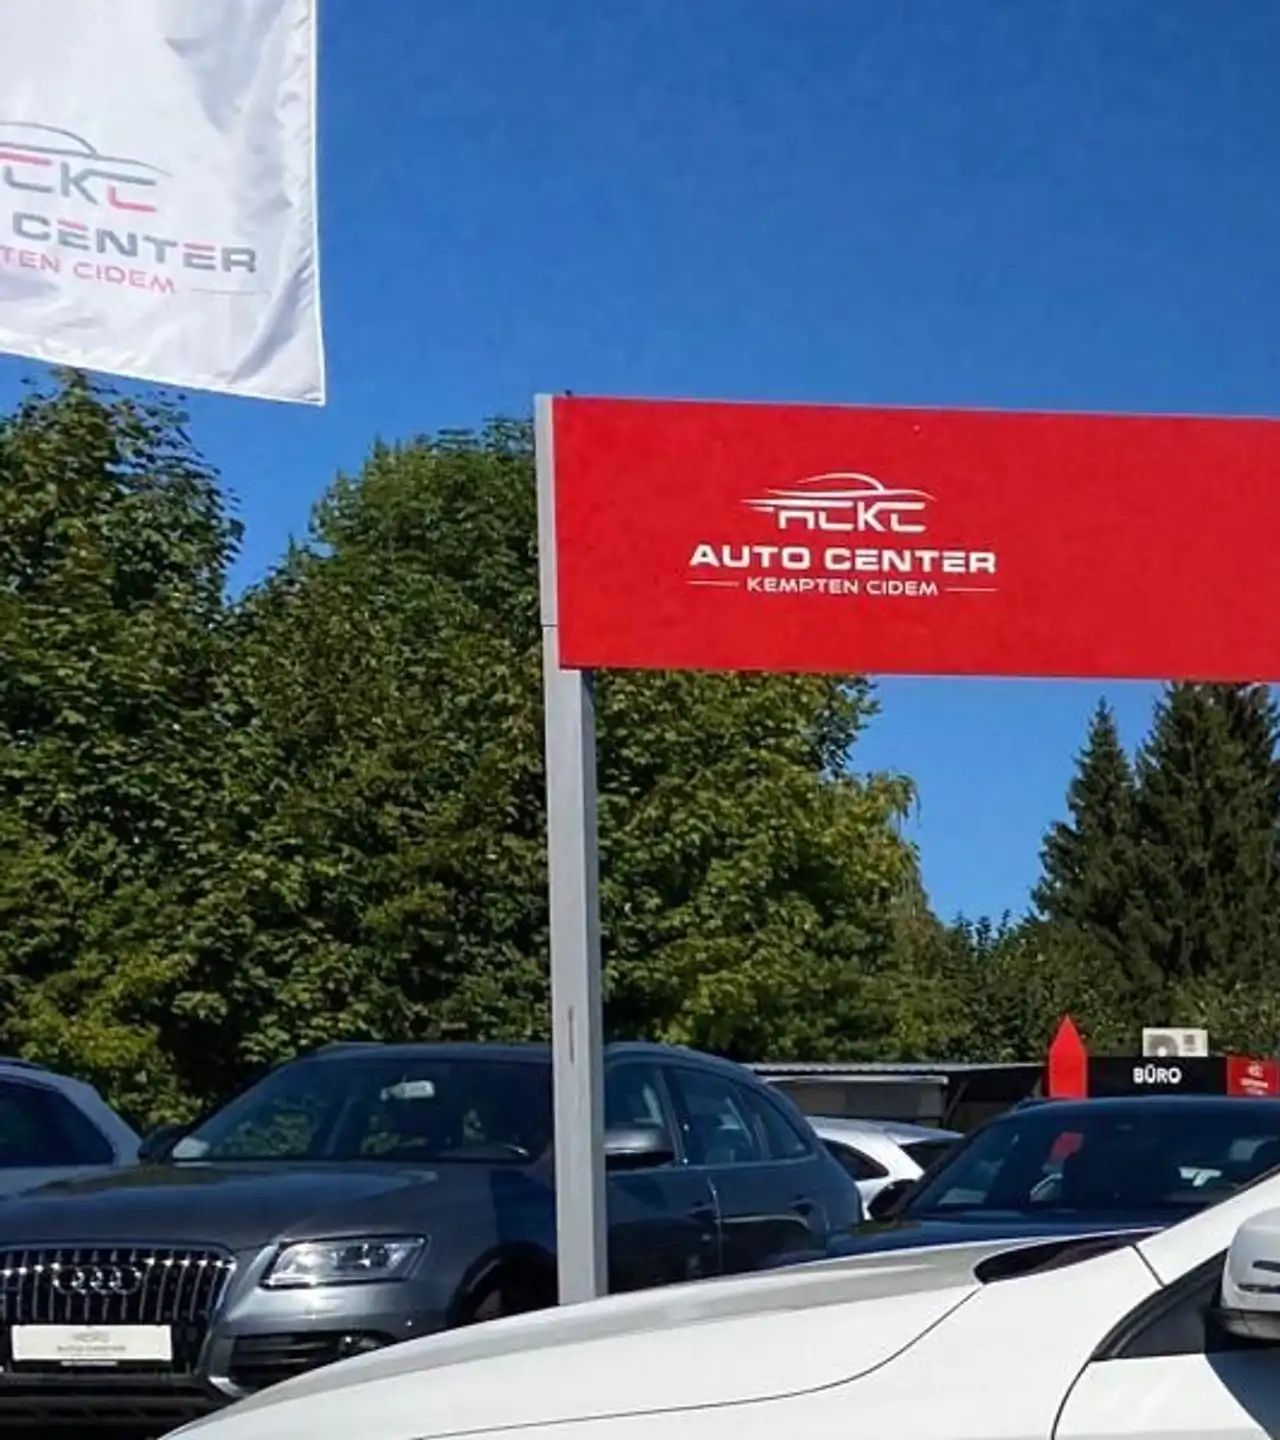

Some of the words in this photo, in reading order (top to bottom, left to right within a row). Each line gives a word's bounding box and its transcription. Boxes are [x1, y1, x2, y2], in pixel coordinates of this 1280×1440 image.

[12, 210, 258, 274] CENTER
[72, 261, 177, 294] CIDEM
[689, 544, 811, 569] AUTO
[824, 547, 997, 574] CENTER
[746, 576, 859, 595] KEMPTEN
[866, 579, 938, 597] CIDEM
[1132, 1063, 1182, 1084] BÜRO
